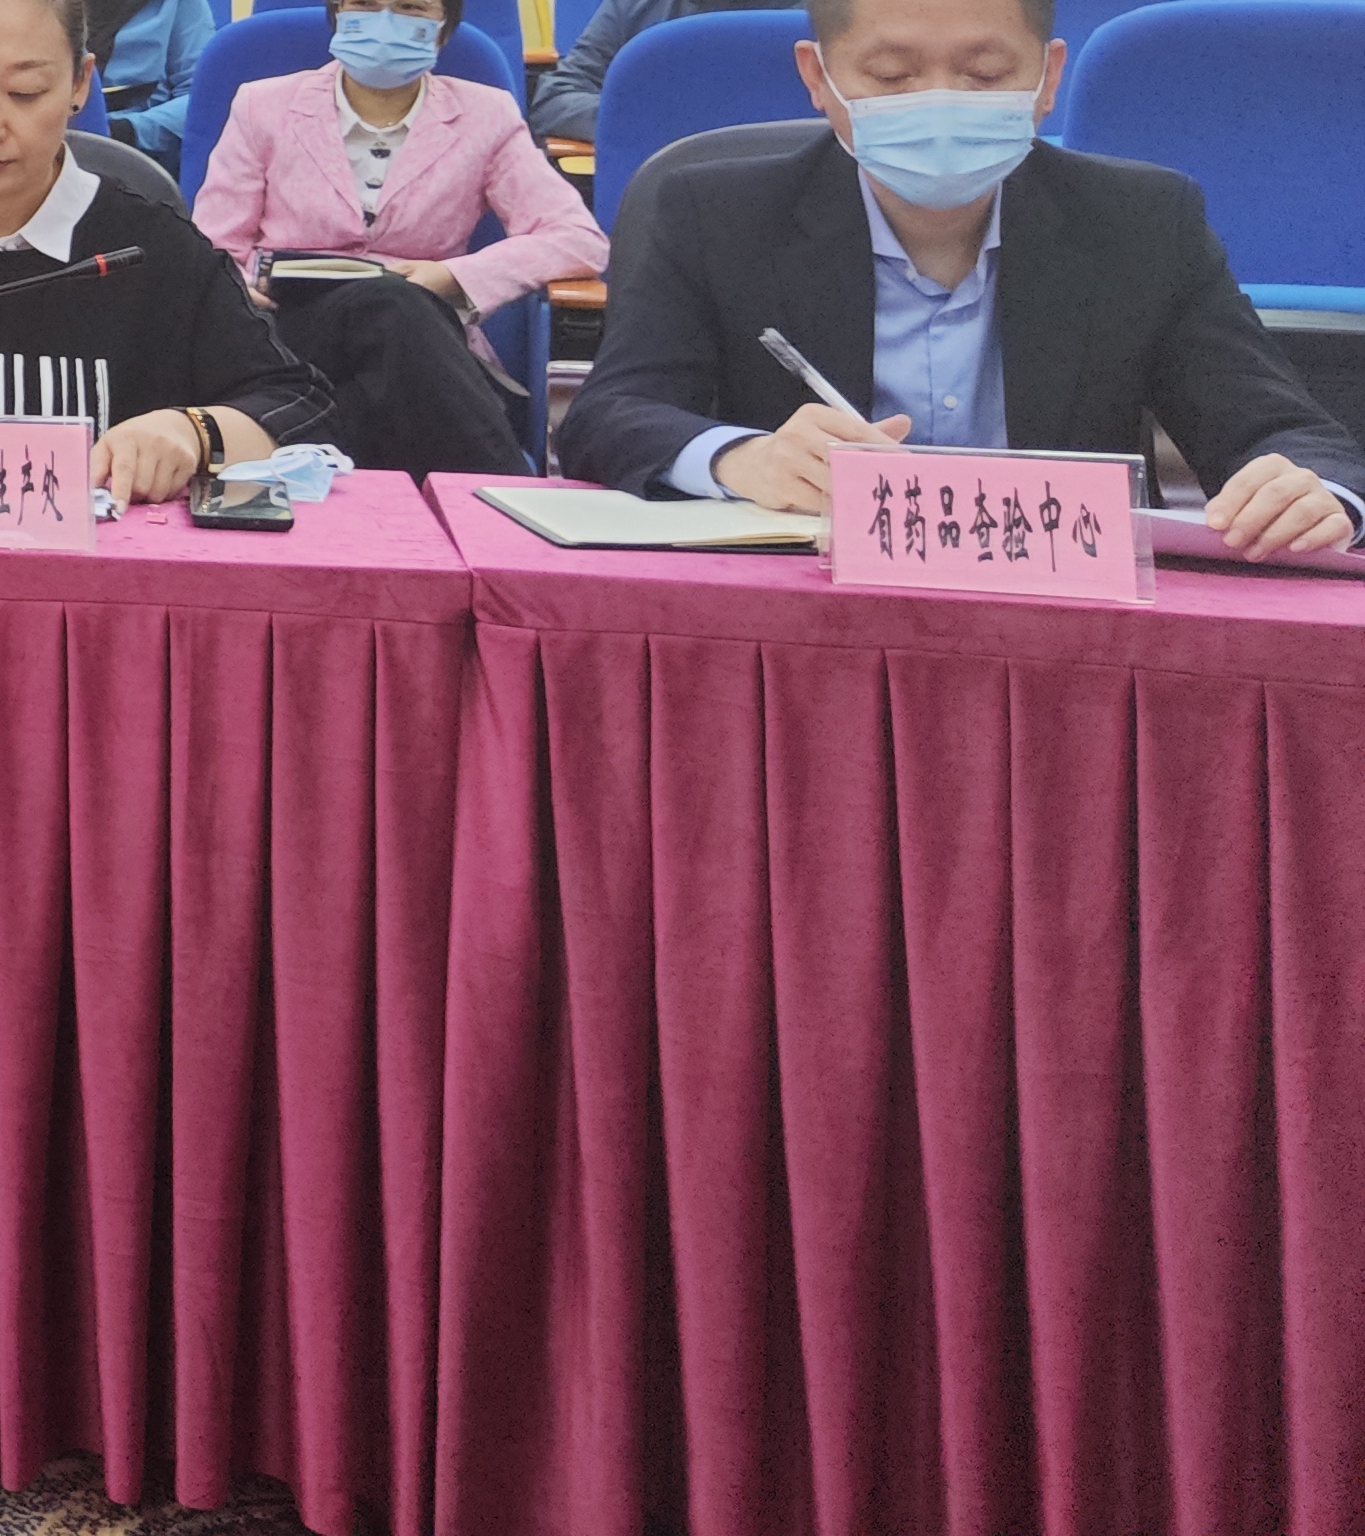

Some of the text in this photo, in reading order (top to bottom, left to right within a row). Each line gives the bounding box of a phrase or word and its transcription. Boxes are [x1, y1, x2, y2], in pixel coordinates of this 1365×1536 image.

[868, 473, 1102, 573] 省药品查验中心
